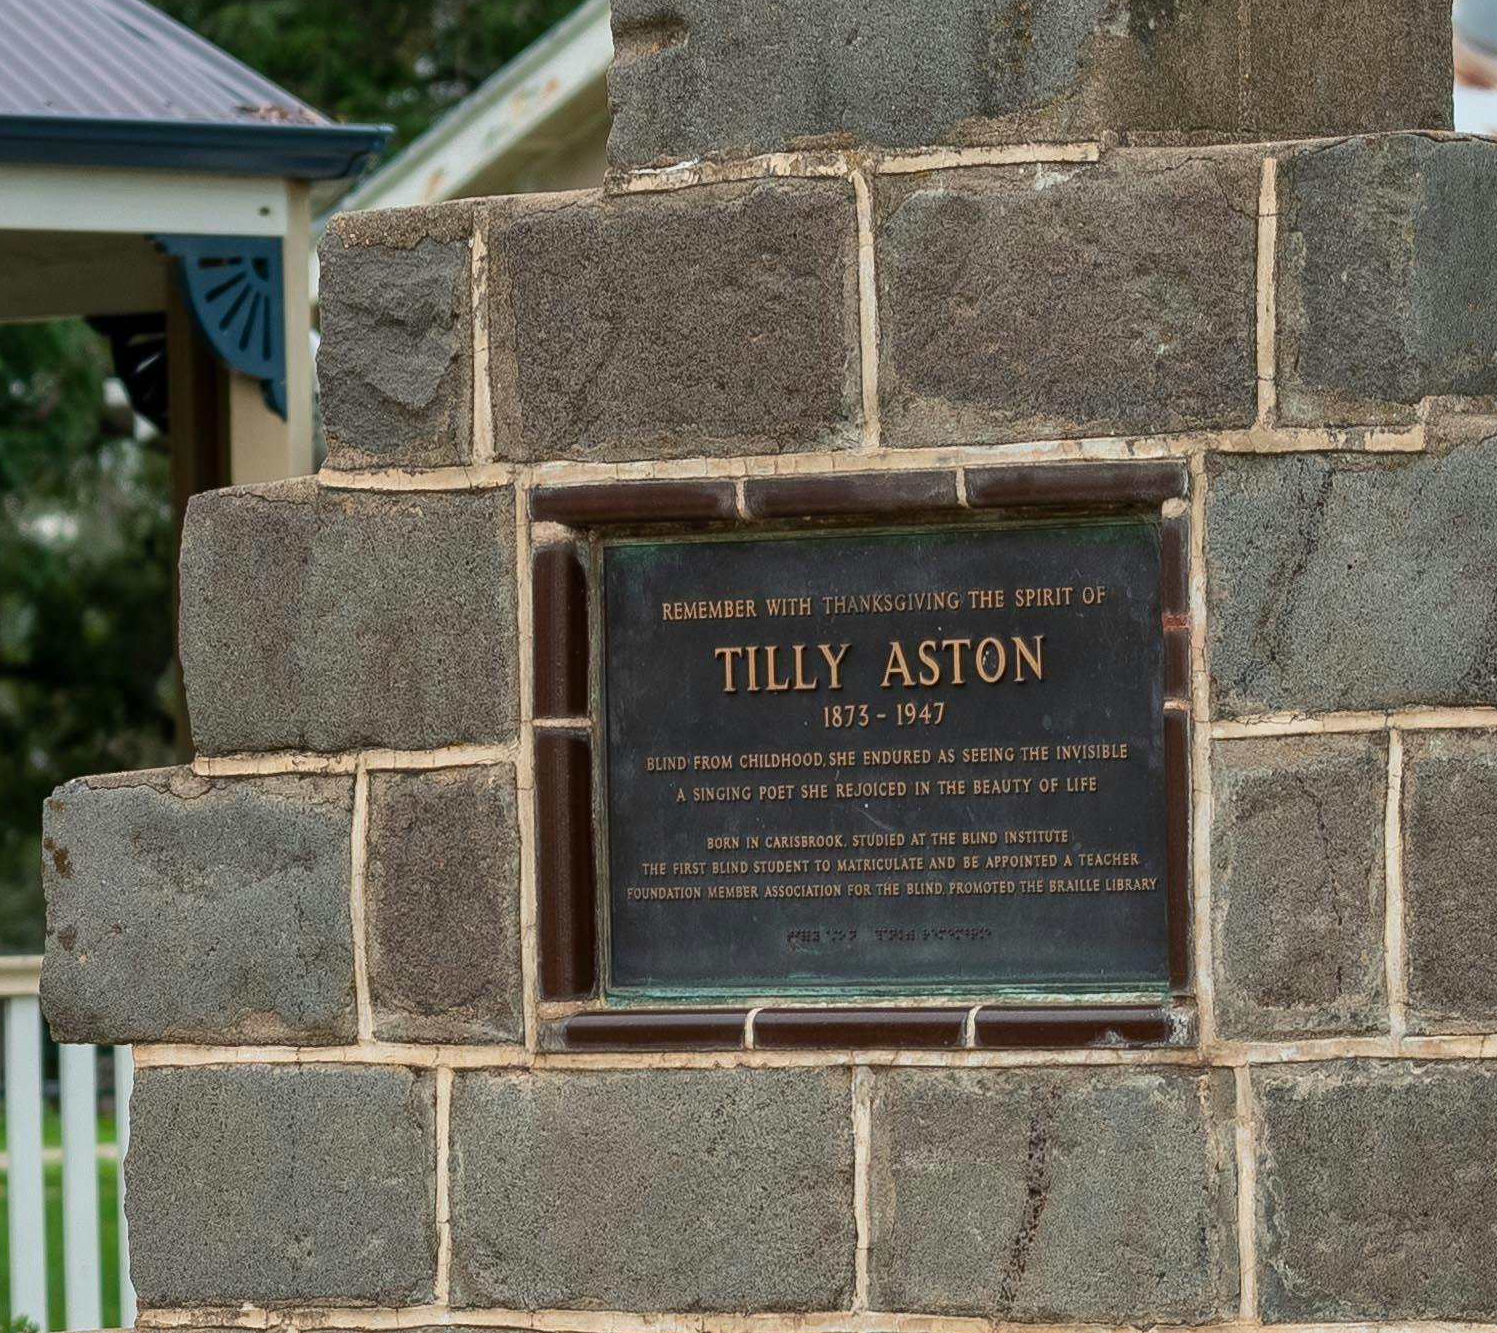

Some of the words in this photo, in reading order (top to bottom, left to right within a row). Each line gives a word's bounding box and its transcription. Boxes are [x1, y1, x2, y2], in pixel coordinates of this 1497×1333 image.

[662, 599, 757, 620] REMEMBER
[766, 597, 811, 616] WITH
[822, 592, 960, 615] THANKSGIVING
[968, 589, 1004, 609] THE
[1015, 587, 1073, 607] SPIRIT
[1082, 586, 1105, 605] OF
[714, 642, 852, 692] TILLY
[880, 634, 1045, 688] ASTON
[823, 704, 869, 728] 1873
[896, 702, 944, 727] 1947
[646, 756, 687, 771] BLIND
[694, 754, 732, 769] FROM
[829, 751, 855, 766] SHE
[863, 749, 931, 765] ENDURED
[938, 748, 955, 763] AS
[962, 747, 1014, 763] SEEING
[1020, 746, 1048, 761] THE
[1056, 744, 1128, 760] INVISIBLE
[676, 788, 686, 803] A
[693, 786, 752, 801] SINGING
[759, 784, 794, 800] POET
[801, 784, 828, 799] SHE
[836, 782, 906, 798] REJOICED
[915, 781, 930, 796] IN
[938, 780, 965, 795] THE
[973, 778, 1032, 795] BEAUTY
[1039, 778, 1058, 793] OF
[1067, 776, 1097, 792] LIFE
[707, 836, 740, 849] BORN
[746, 836, 759, 849] IN
[853, 833, 904, 847] STUDIED
[910, 833, 926, 846] AT
[931, 832, 955, 845] THE
[962, 832, 997, 845] BLIND
[1004, 829, 1068, 843] INSTITUTE
[642, 862, 667, 875] THE
[673, 862, 706, 875] FIRST
[712, 861, 748, 874] BLIND
[753, 860, 810, 873] STUDENT
[815, 859, 830, 872] TO
[837, 857, 924, 872] MATRICULATE
[929, 856, 955, 869] AND
[963, 856, 979, 869] BE
[985, 854, 1057, 868] APPOINTED
[1064, 854, 1073, 867] A
[1078, 853, 1140, 866] TEACHER
[627, 886, 701, 900] FOUNDATION
[707, 886, 759, 899] MEMBER
[764, 884, 841, 898] ASSOCIATION
[847, 883, 871, 896] FOR
[876, 883, 900, 896] THE
[949, 880, 1015, 895] PROMOTED
[1019, 880, 1043, 893] THE
[1049, 879, 1100, 892] BRAILLE
[1106, 877, 1158, 891] LIBRARY
